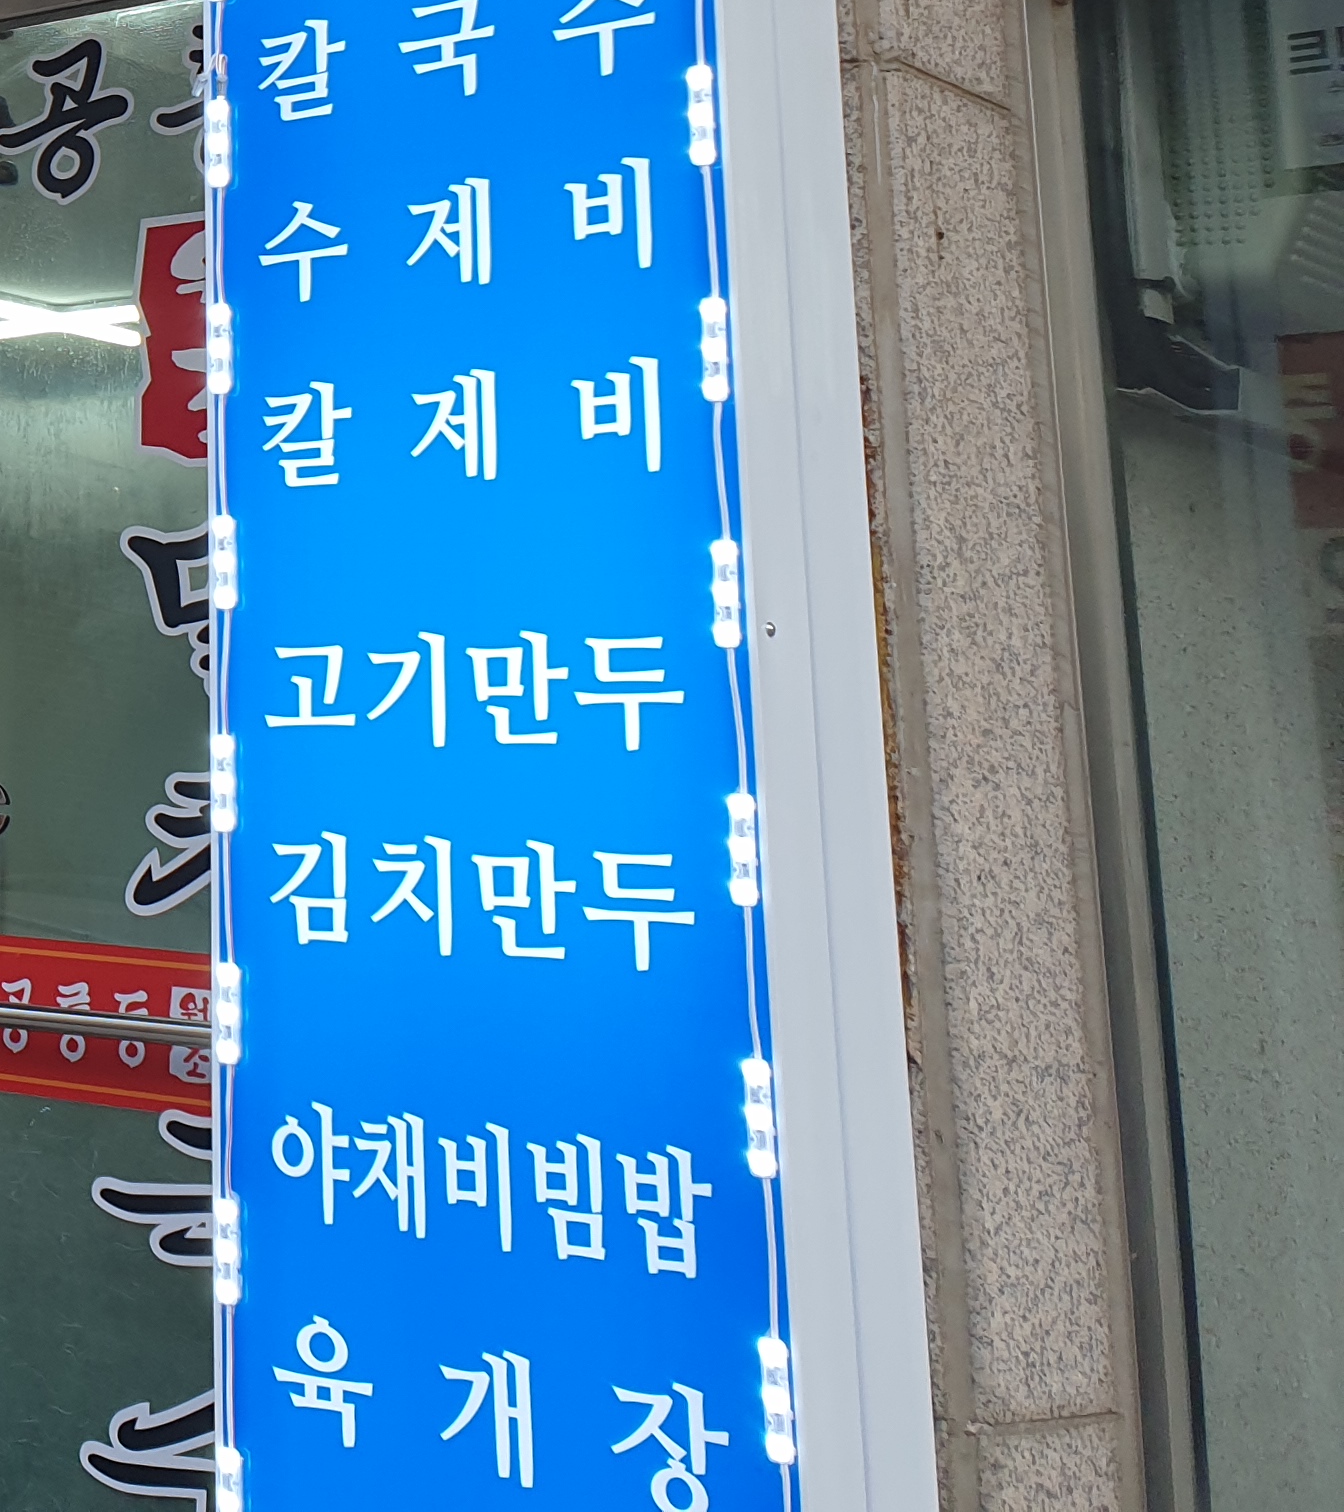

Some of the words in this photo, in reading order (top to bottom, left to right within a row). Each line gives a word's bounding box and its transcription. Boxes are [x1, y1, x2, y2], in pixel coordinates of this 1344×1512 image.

[257, 156, 653, 304] 수제비
[262, 355, 664, 489] 칼제비
[264, 630, 685, 752] 고기만두
[268, 830, 697, 972] 김치만두
[271, 1100, 713, 1280] 야채비빔밥
[273, 1314, 730, 1512] 육개장
